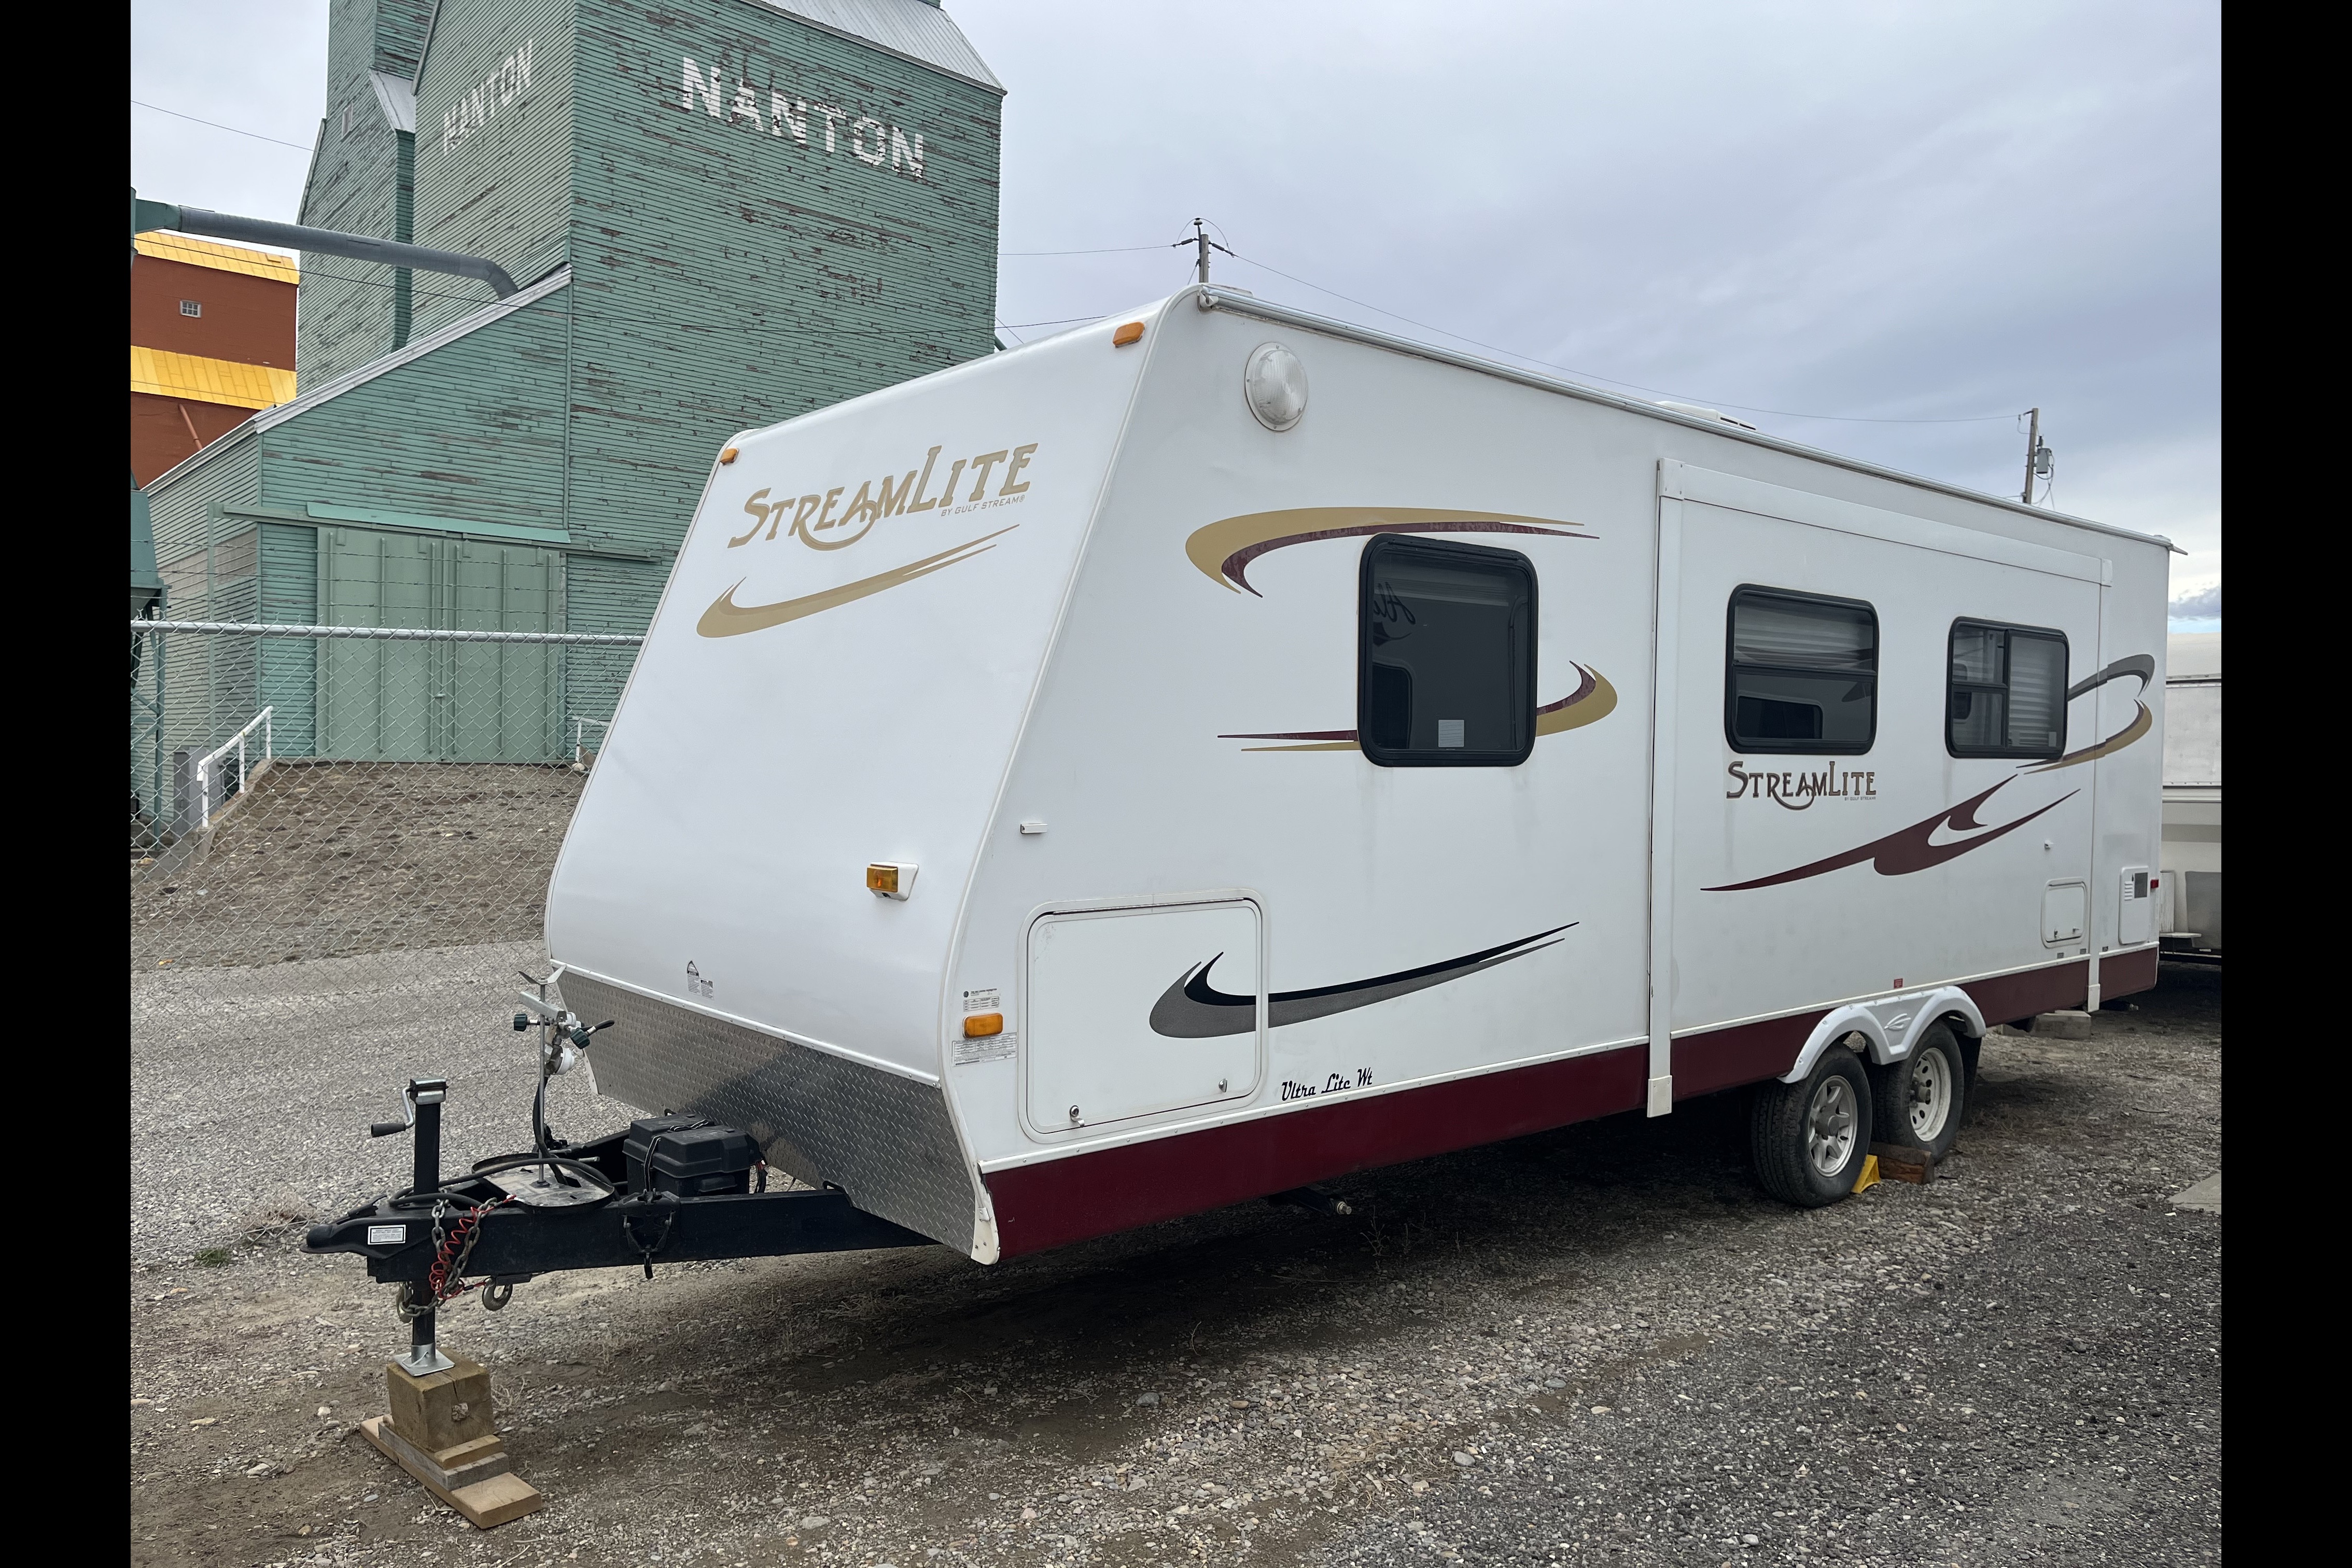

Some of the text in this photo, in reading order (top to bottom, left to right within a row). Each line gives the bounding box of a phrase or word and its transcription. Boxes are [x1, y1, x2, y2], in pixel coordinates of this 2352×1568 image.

[442, 38, 533, 156] NANTON
[681, 55, 925, 180] NANTON
[941, 508, 953, 517] BY
[955, 503, 979, 514] GULF
[1281, 1067, 1373, 1101] Ultra Lite Wt
